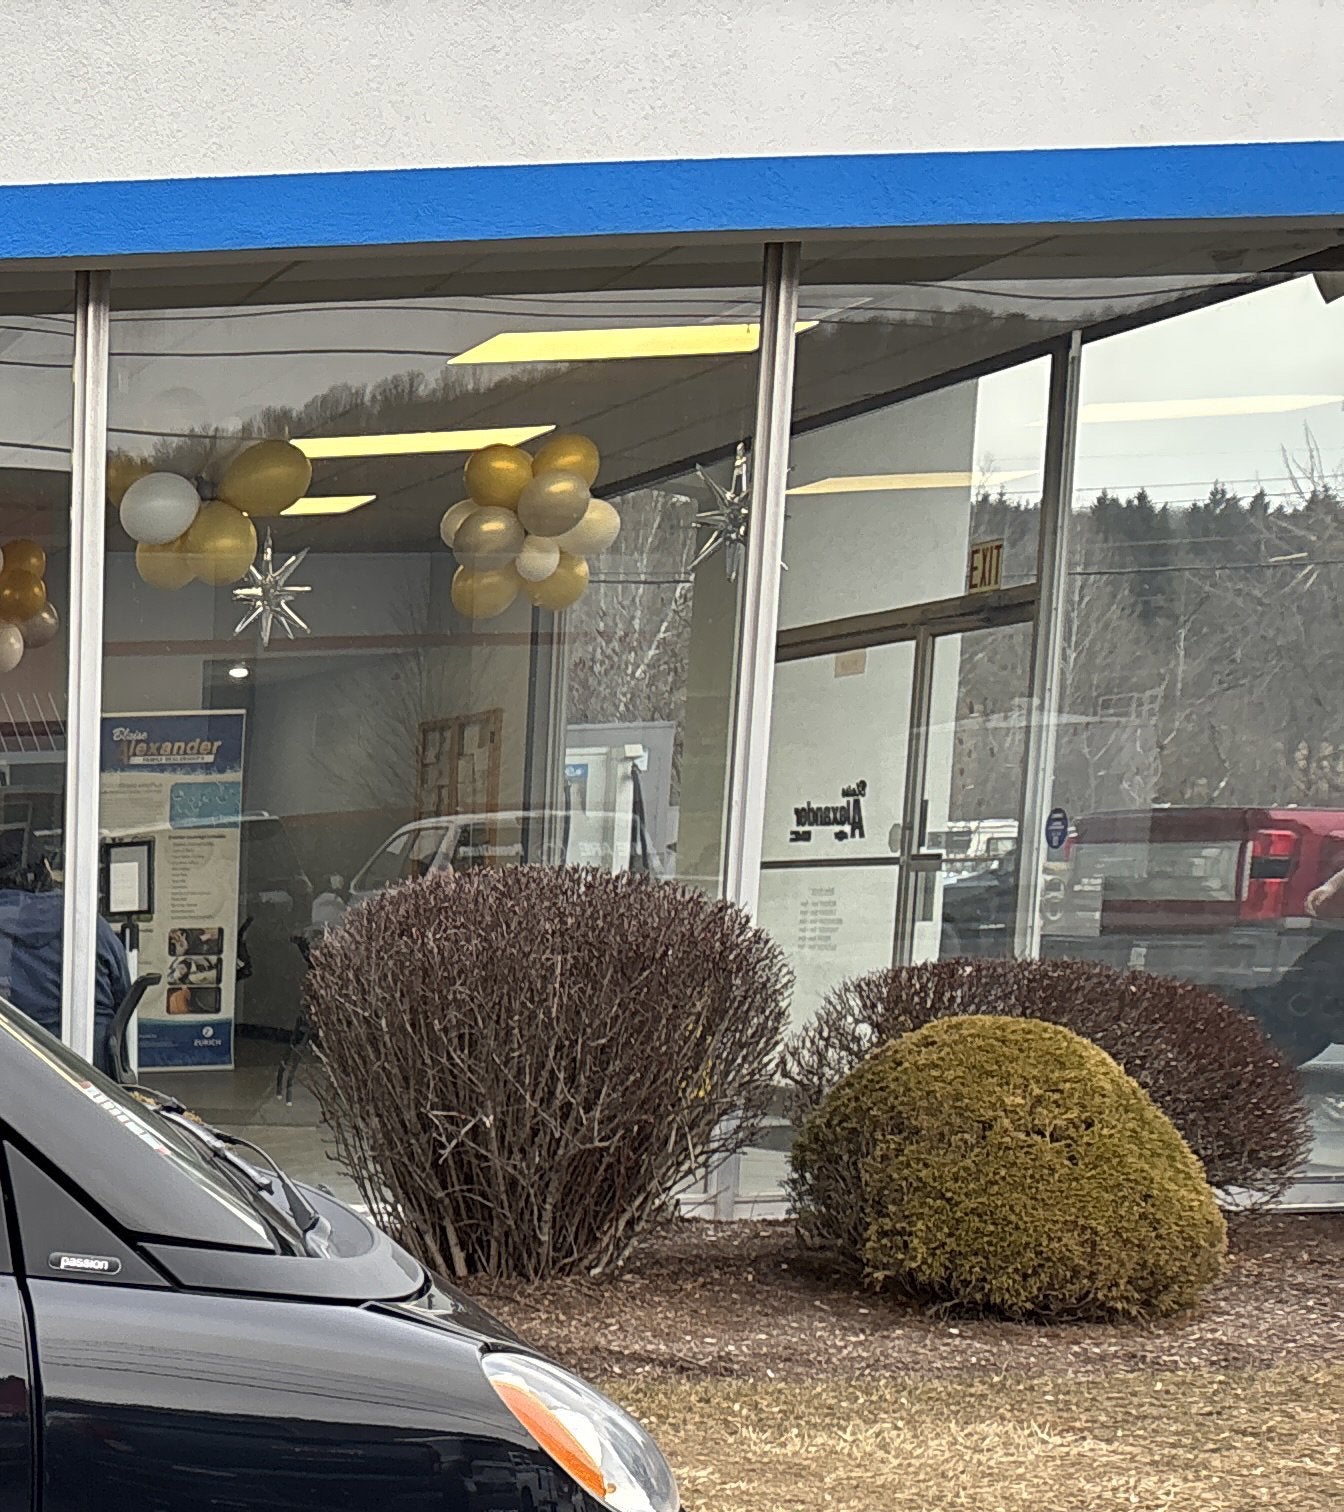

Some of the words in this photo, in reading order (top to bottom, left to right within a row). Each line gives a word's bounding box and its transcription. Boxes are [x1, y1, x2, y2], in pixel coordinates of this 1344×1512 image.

[969, 544, 1003, 588] EXIT
[112, 727, 148, 741] Blaise
[193, 1038, 223, 1048] ZURICH
[60, 1255, 109, 1271] passion
